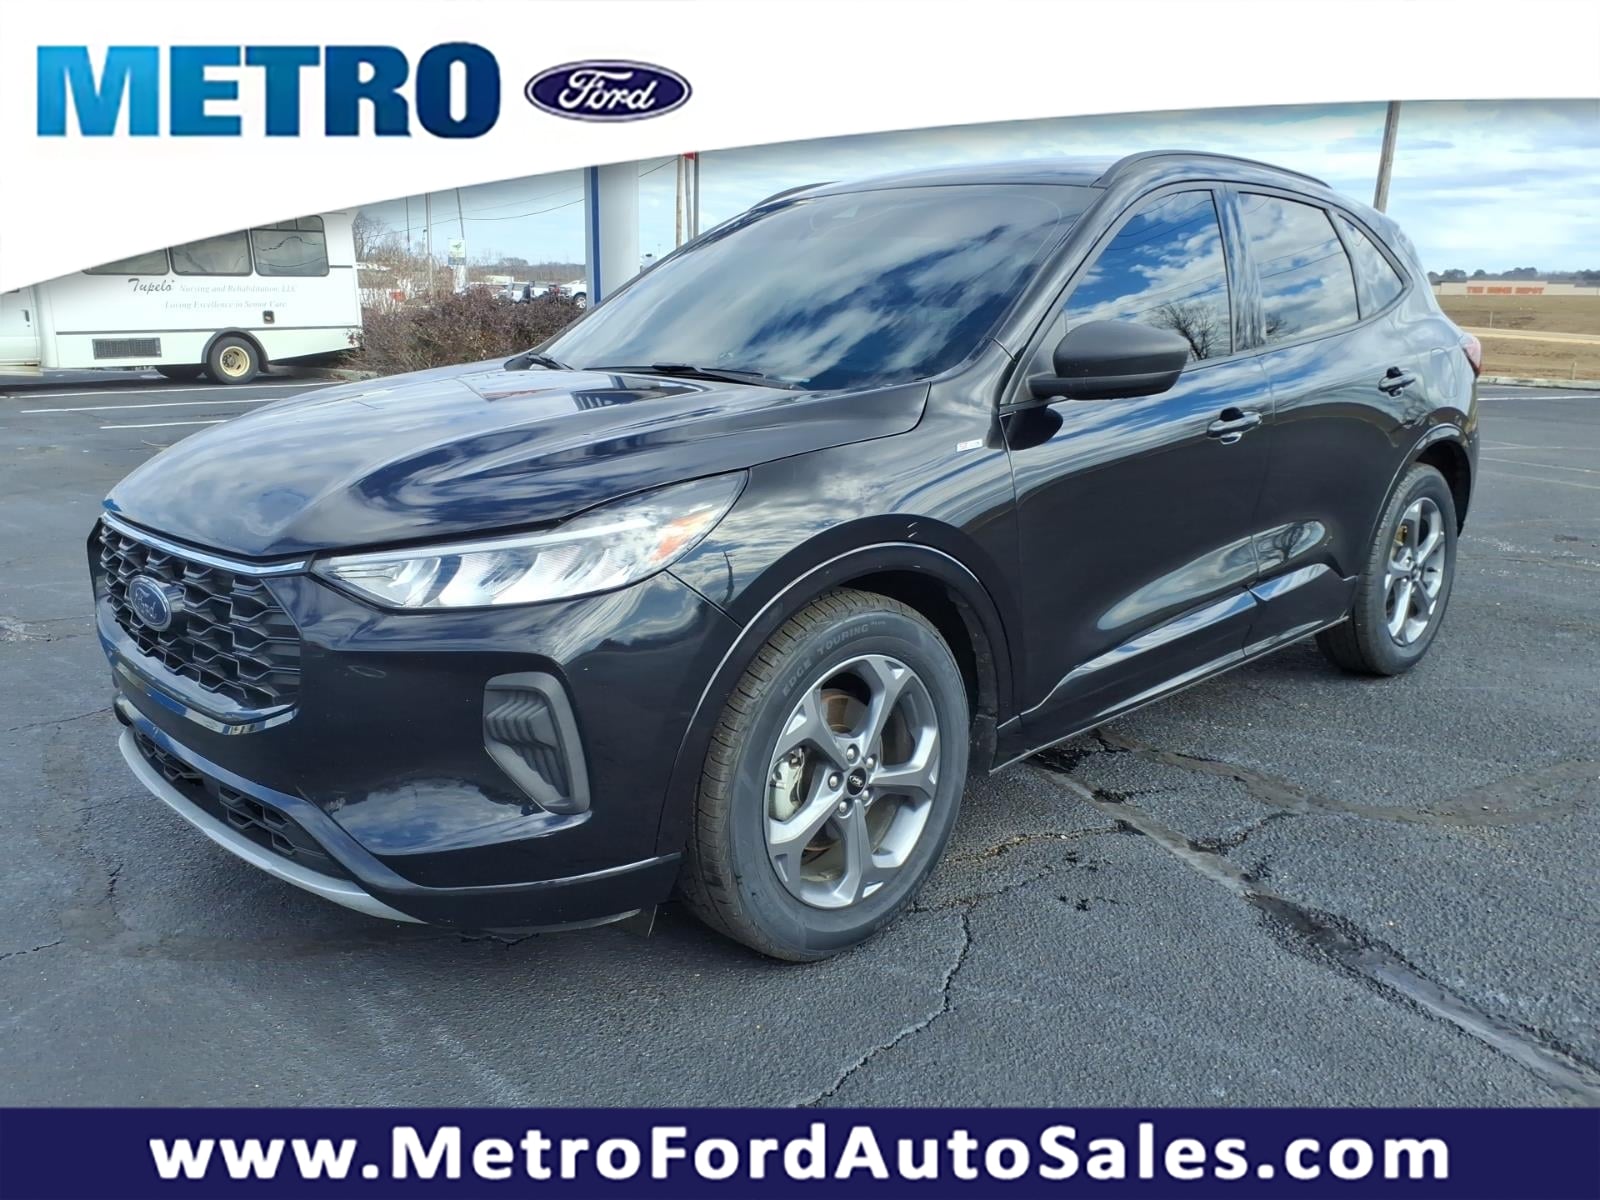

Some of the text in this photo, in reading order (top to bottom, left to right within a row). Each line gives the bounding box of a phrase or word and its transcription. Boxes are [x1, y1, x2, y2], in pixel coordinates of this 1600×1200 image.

[128, 277, 173, 296] Tupelo
[211, 284, 226, 293] and
[816, 624, 869, 655] TOURING
